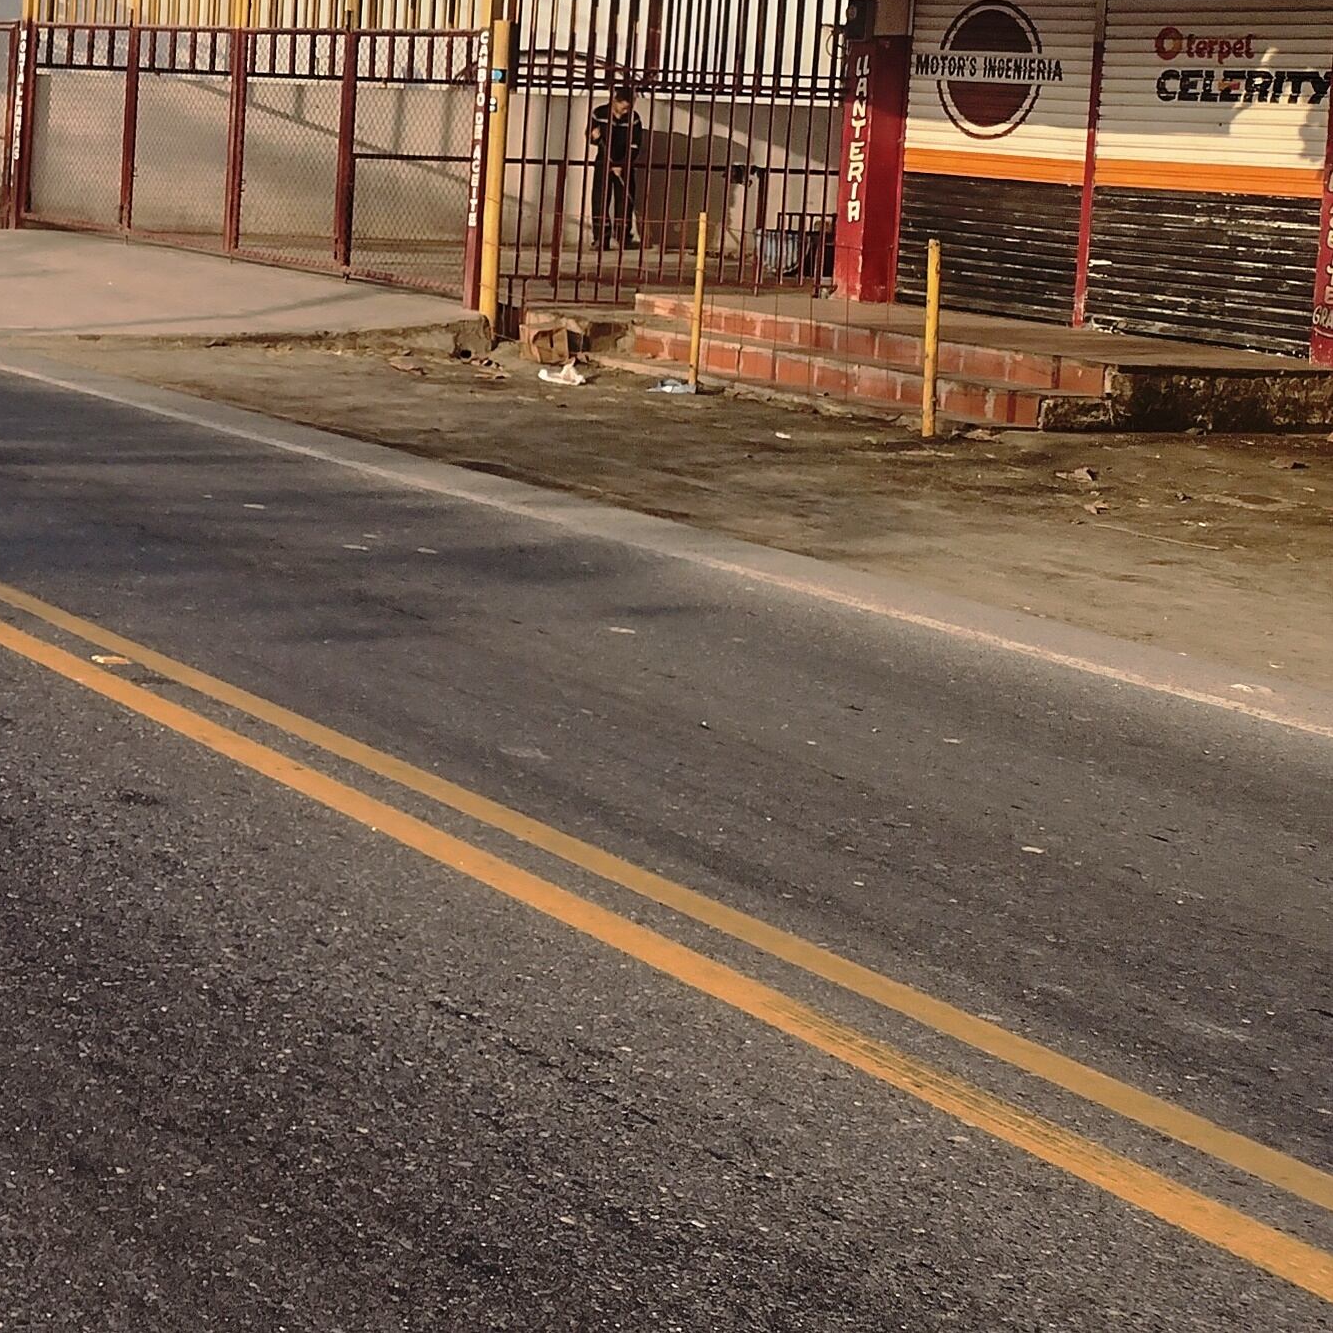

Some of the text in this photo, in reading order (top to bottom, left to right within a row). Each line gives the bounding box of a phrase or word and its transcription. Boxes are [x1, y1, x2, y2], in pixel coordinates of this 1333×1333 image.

[476, 31, 490, 106] CAMBIO
[915, 54, 1063, 82] MOTOR'S INGENIERIA
[1156, 69, 1332, 104] CELERITY
[474, 112, 484, 140] DE
[847, 54, 871, 223] LLANTERIA
